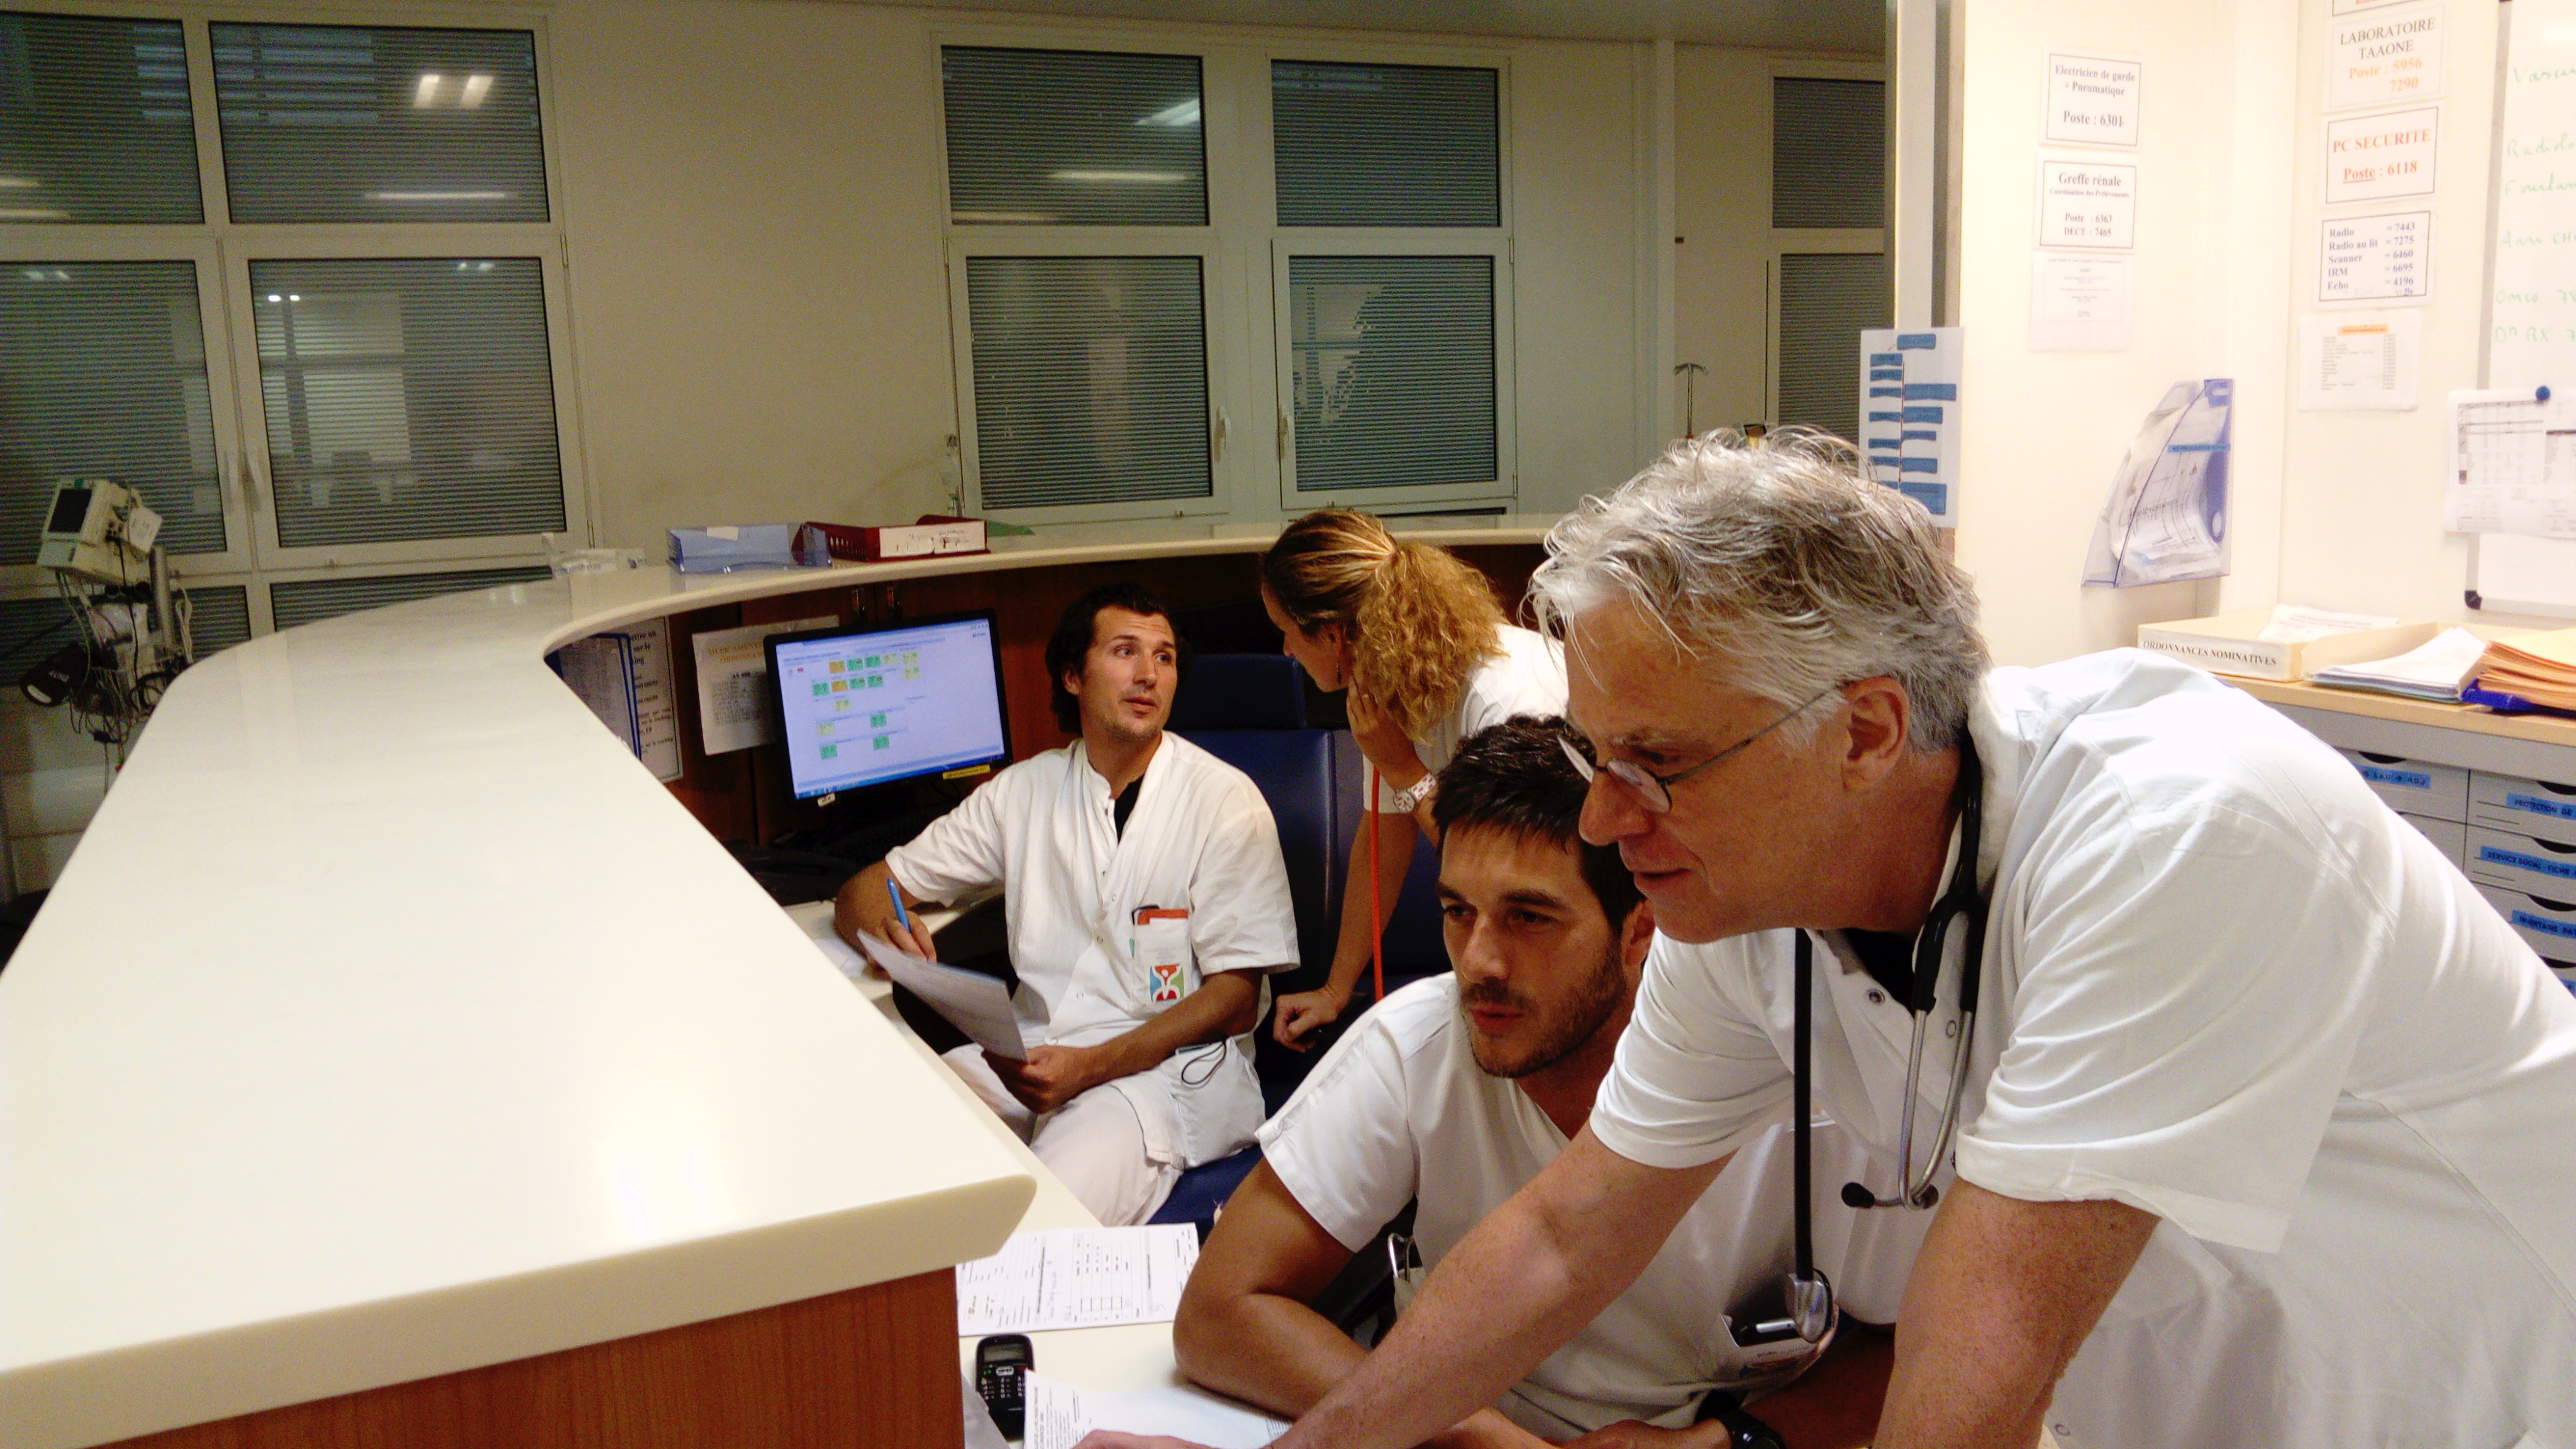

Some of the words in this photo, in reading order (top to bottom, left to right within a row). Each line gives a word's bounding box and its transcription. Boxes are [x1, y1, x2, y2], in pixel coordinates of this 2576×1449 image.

[2340, 18, 2435, 45] LABORATOIRE
[2359, 40, 2414, 60] TAAONE
[2101, 69, 2110, 79] de
[2112, 72, 2135, 82] garde
[2350, 65, 2380, 80] Poste
[2072, 81, 2125, 97] Pneumatique
[2063, 110, 2090, 125] Poste
[2333, 139, 2351, 153] PC
[2355, 129, 2431, 150] SECURITE
[2344, 167, 2375, 182] Poste
[2388, 160, 2418, 175] 6118
[2058, 172, 2089, 186] Greffe
[2093, 174, 2121, 187] rénale
[2065, 213, 2084, 222] Poste
[2329, 228, 2354, 238] Radio
[2329, 241, 2353, 250] Radio
[2369, 239, 2378, 248] lit
[2328, 254, 2363, 264] Scanner
[2328, 267, 2348, 277] IRM
[2328, 280, 2349, 290] Echo
[2143, 640, 2208, 657] ORDONNANCES
[2211, 649, 2277, 666] NOMINATIVES
